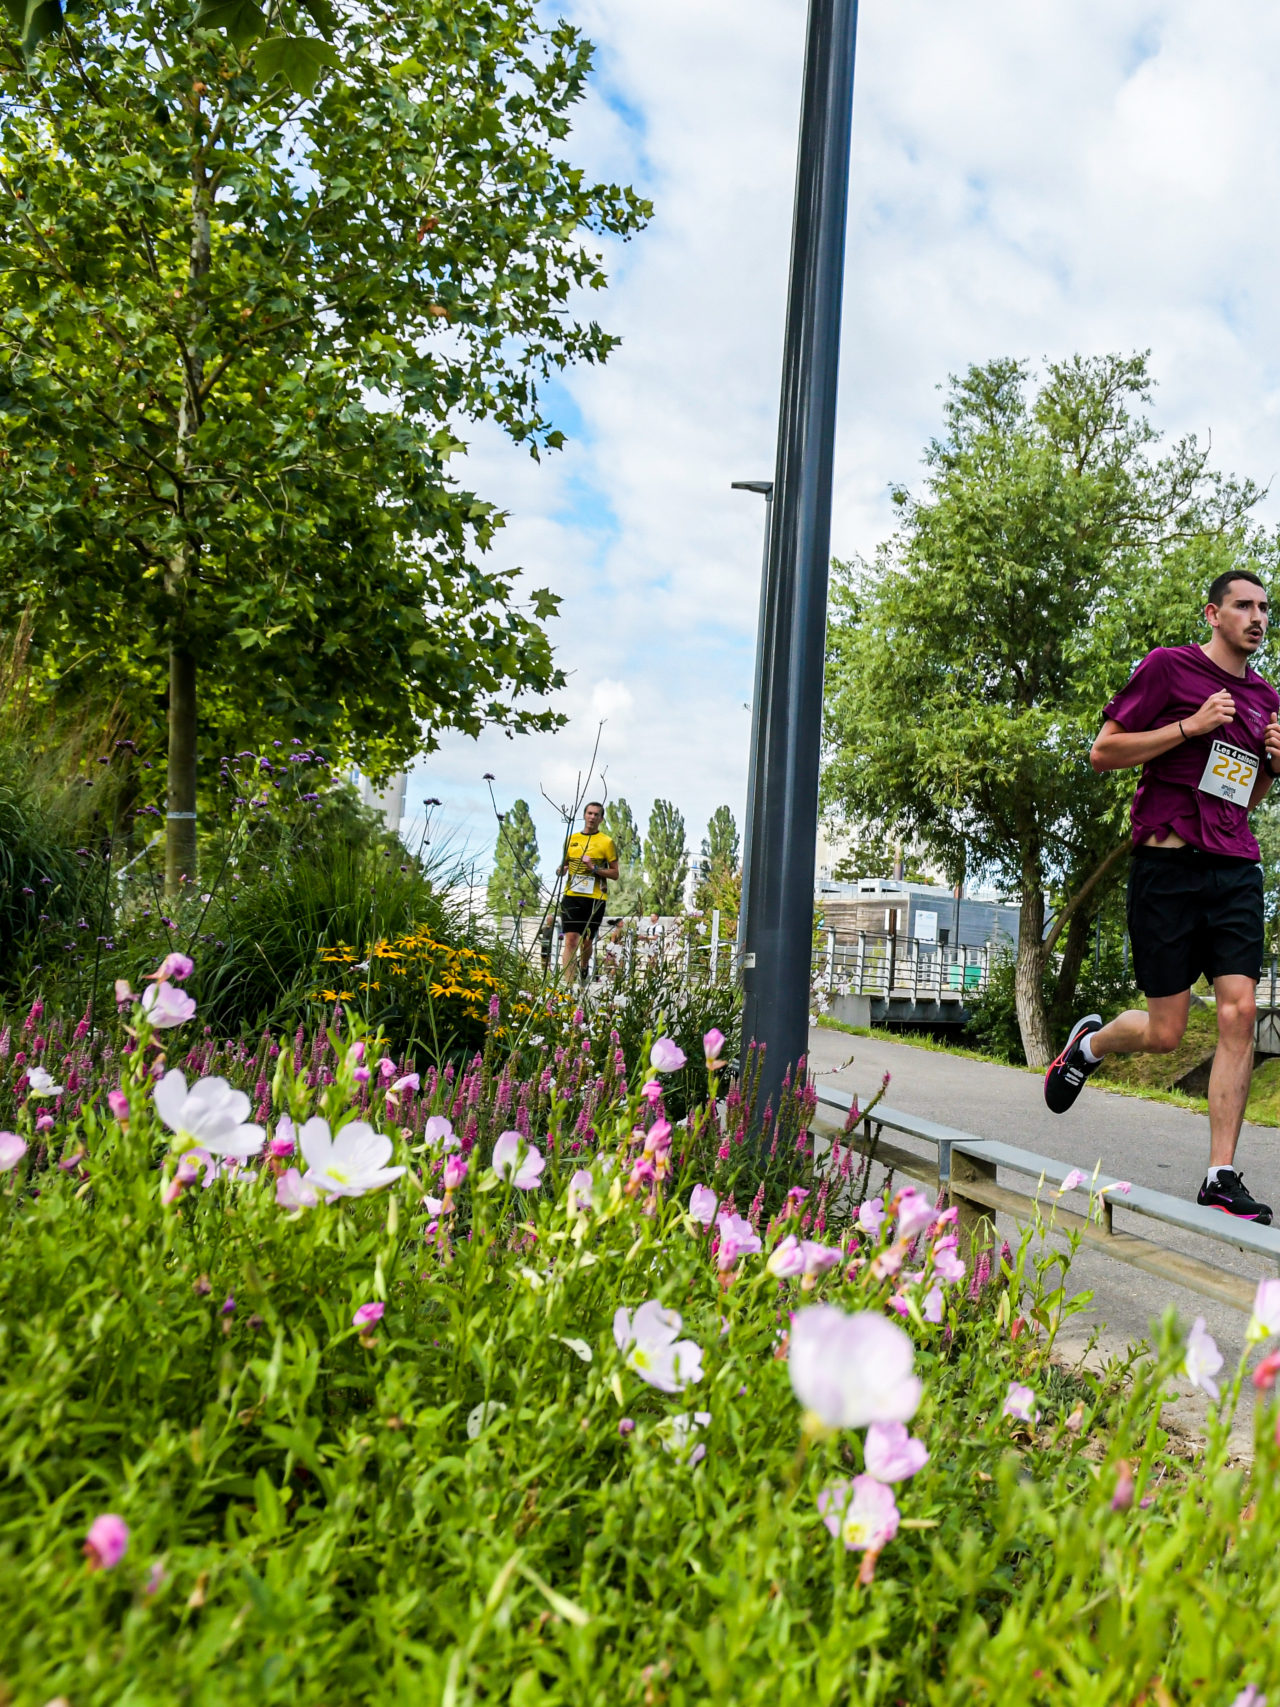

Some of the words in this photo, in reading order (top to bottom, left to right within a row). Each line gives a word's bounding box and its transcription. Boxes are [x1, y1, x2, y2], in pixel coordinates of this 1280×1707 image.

[1215, 743, 1231, 756] Les
[1231, 750, 1238, 758] 4
[1212, 755, 1254, 787] 222
